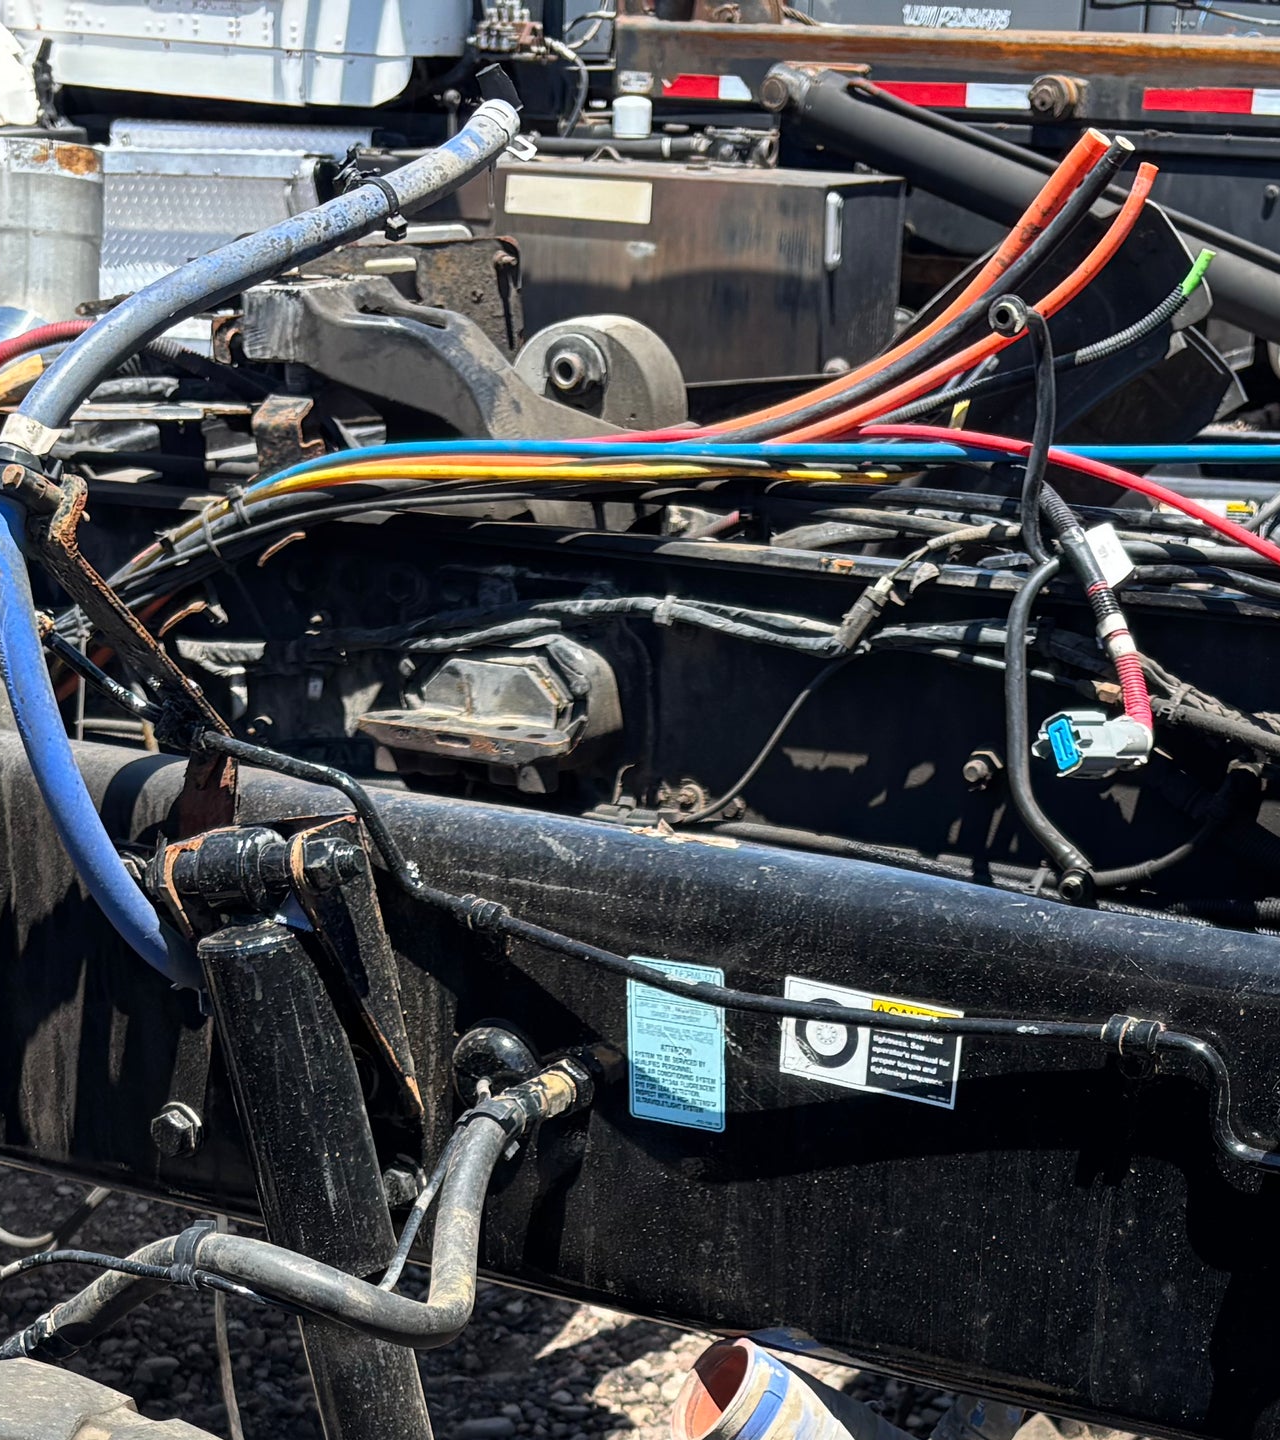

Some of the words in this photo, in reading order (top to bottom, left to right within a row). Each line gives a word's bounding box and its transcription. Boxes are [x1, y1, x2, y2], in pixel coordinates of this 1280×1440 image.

[910, 1041, 925, 1051] See
[872, 1046, 910, 1059] operator's
[910, 1053, 938, 1065] manual
[939, 1058, 950, 1067] for
[870, 1065, 908, 1080] tightening
[871, 1056, 897, 1067] proper
[896, 1060, 922, 1071] torque
[922, 1066, 937, 1075] and
